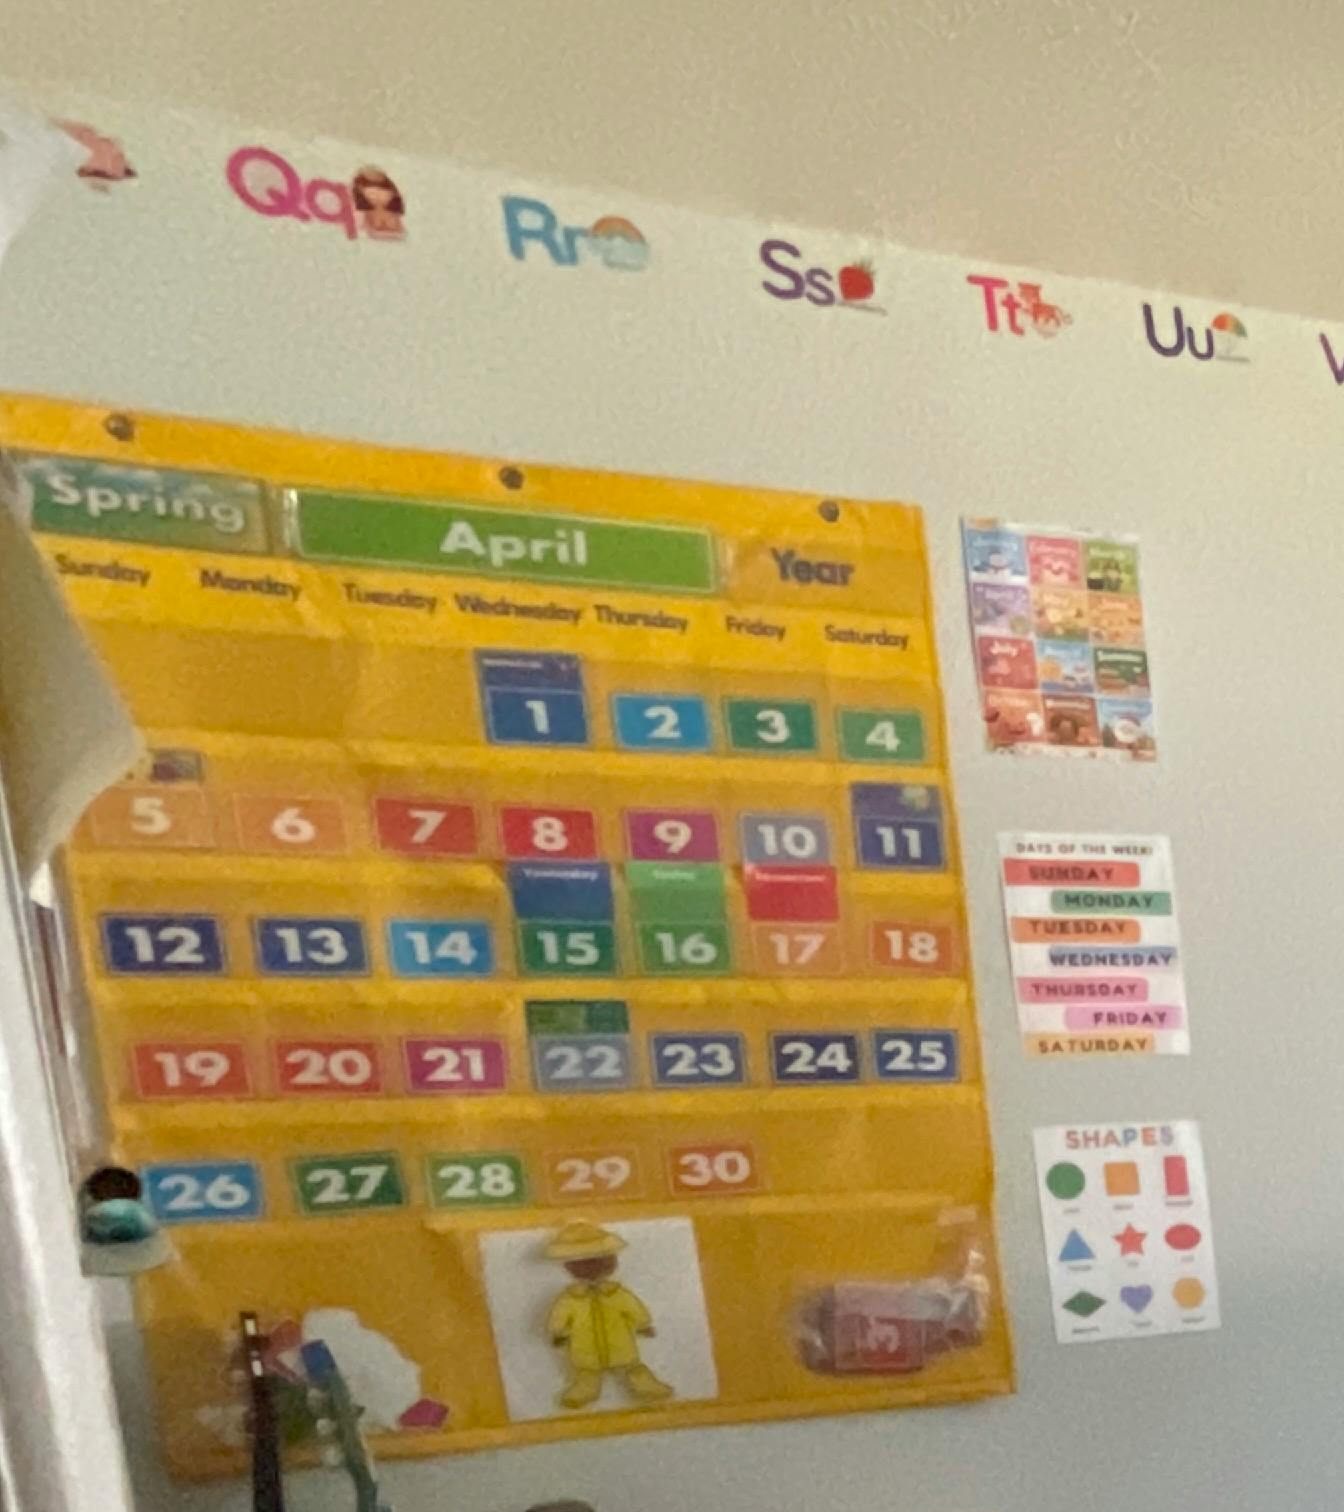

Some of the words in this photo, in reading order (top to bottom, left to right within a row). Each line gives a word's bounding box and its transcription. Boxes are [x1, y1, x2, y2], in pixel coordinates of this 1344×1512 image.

[226, 146, 358, 241] Qq
[500, 194, 596, 266] Rr
[759, 238, 837, 308] Ss
[967, 274, 1027, 337] Tt
[1141, 302, 1214, 361] Uu
[46, 472, 246, 535] Spring
[439, 519, 589, 569] April
[770, 546, 856, 588] Year
[53, 553, 152, 588] Sunday
[198, 567, 303, 602] Monday
[342, 582, 438, 615] Tuesday
[452, 593, 584, 626] Wednesday
[593, 604, 690, 634] Thursday
[725, 615, 787, 642] Friday
[822, 623, 910, 651] Saturday
[525, 699, 550, 735] 1
[644, 705, 683, 740] 2
[756, 709, 791, 744] 3
[865, 720, 901, 752] 4
[130, 797, 172, 835] 5
[270, 806, 316, 844] 6
[407, 809, 446, 844] 7
[532, 816, 568, 852] 8
[652, 820, 693, 854] 9
[758, 824, 817, 858] 10
[876, 825, 924, 859] 11
[1016, 841, 1053, 855] DAYS
[1057, 842, 1077, 854] OF
[1081, 843, 1107, 855] THE
[1028, 866, 1116, 881] SUNDAY
[1063, 894, 1155, 908] MONDAY
[1028, 919, 1128, 935] TUESDAY
[126, 925, 206, 965] 12
[275, 926, 349, 965] 13
[407, 931, 478, 965] 14
[537, 930, 600, 967] 15
[655, 931, 718, 966] 16
[770, 932, 828, 965] 17
[884, 929, 940, 963] 18
[1049, 952, 1174, 967] WEDNESDAY
[1031, 982, 1139, 997] THURSDAY
[1092, 1011, 1169, 1026] FRIDAY
[1037, 1038, 1148, 1054] SATURDAY
[154, 1049, 232, 1088] 19
[285, 1048, 373, 1086] 20
[423, 1047, 486, 1082] 21
[545, 1045, 624, 1080] 22
[662, 1042, 737, 1077] 23
[780, 1040, 854, 1074] 24
[881, 1039, 948, 1073] 25
[1064, 1125, 1175, 1150] SHAPES
[156, 1174, 253, 1211] 26
[306, 1164, 390, 1204] 27
[437, 1163, 517, 1199] 28
[556, 1156, 632, 1192] 29
[679, 1150, 751, 1187] 30
